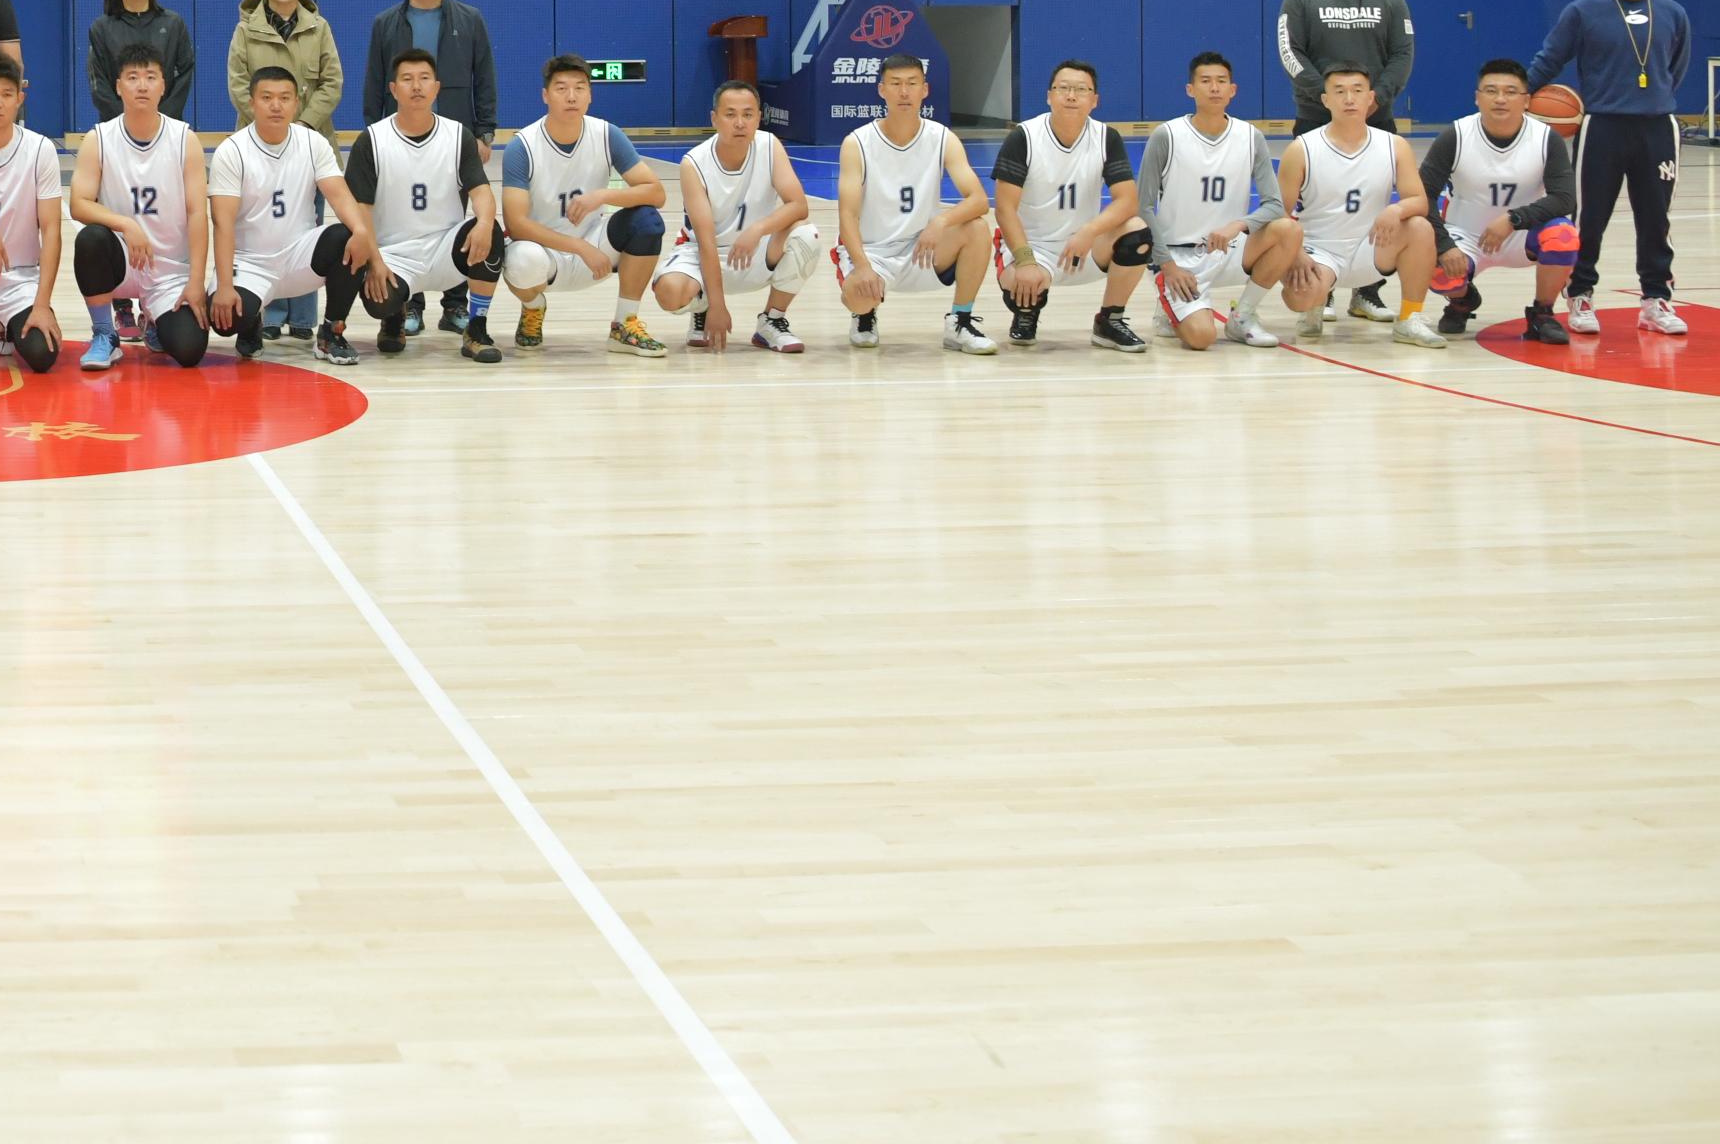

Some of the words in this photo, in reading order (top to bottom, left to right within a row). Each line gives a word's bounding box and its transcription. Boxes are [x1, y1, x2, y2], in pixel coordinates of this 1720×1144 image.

[1319, 7, 1381, 20] LONSDALE
[831, 105, 934, 118] 国际篮联材
[130, 186, 159, 216] 12
[411, 183, 427, 211] 8
[900, 186, 914, 214] 9
[1057, 182, 1076, 210] 11
[1201, 176, 1226, 202] 10
[1345, 188, 1361, 214] 6
[1488, 182, 1518, 208] 17
[272, 190, 286, 218] 5
[558, 189, 583, 218] 1
